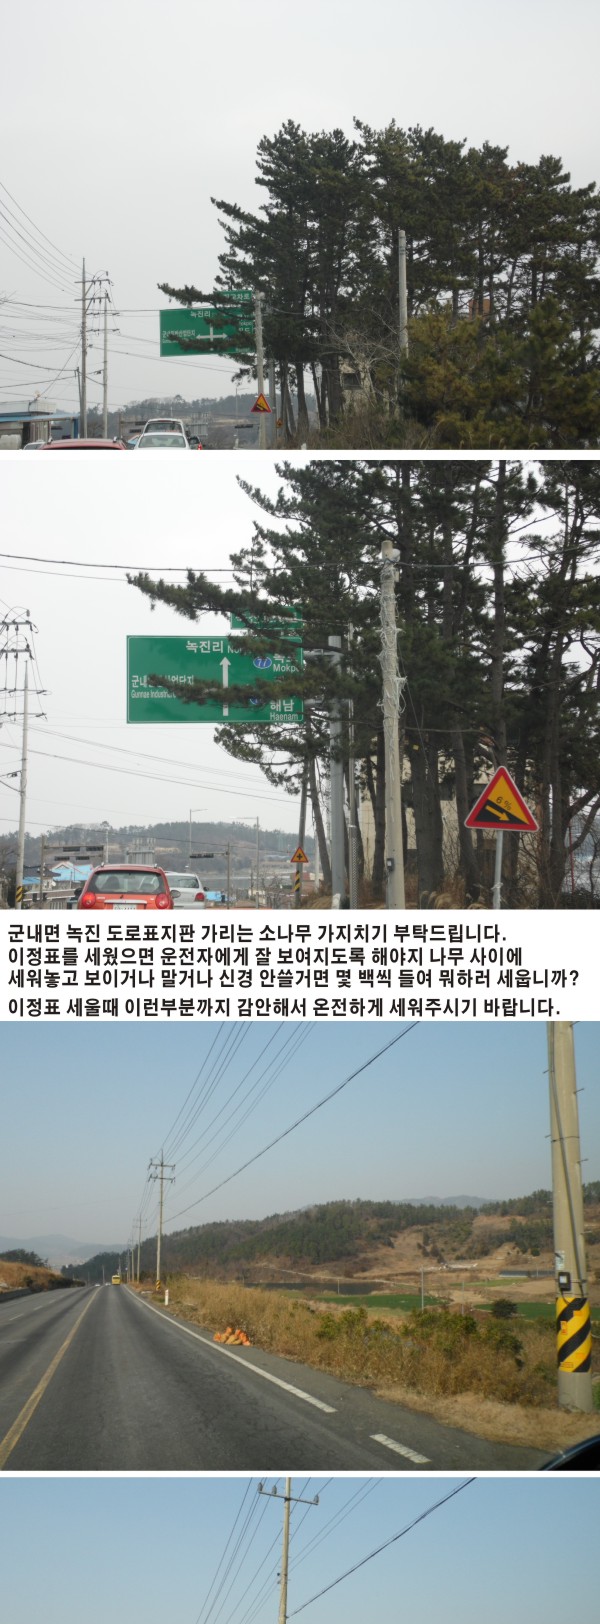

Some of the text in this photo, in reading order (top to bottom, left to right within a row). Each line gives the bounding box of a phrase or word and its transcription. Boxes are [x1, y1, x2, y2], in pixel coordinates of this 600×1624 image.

[186, 640, 223, 653] 녹진리
[270, 699, 295, 712] 해남
[270, 712, 298, 721] Haenam
